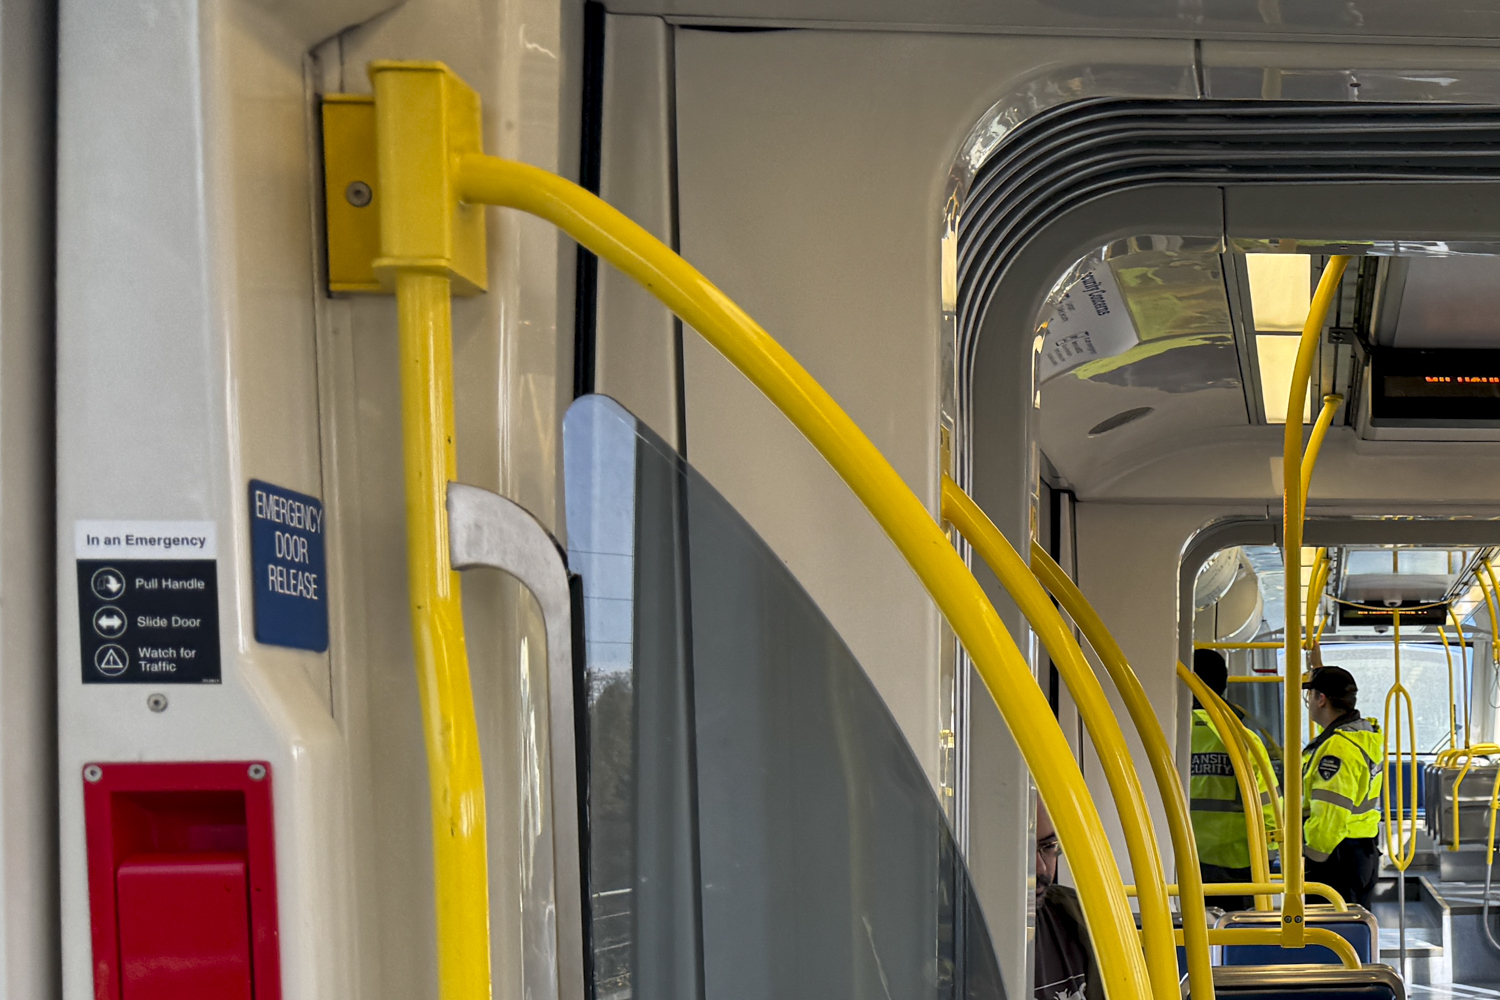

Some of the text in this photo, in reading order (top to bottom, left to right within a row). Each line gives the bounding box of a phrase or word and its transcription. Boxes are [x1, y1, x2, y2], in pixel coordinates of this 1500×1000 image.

[1088, 290, 1110, 316] Concerns
[255, 490, 323, 533] EMERGENCY
[86, 534, 206, 549] In an Emergency
[274, 531, 309, 564] DOOR
[135, 578, 205, 590] Pull Handle
[268, 564, 318, 600] RELEASE
[136, 616, 200, 627] Slide Door
[138, 647, 196, 658] Watch for
[138, 660, 177, 672] Traffic
